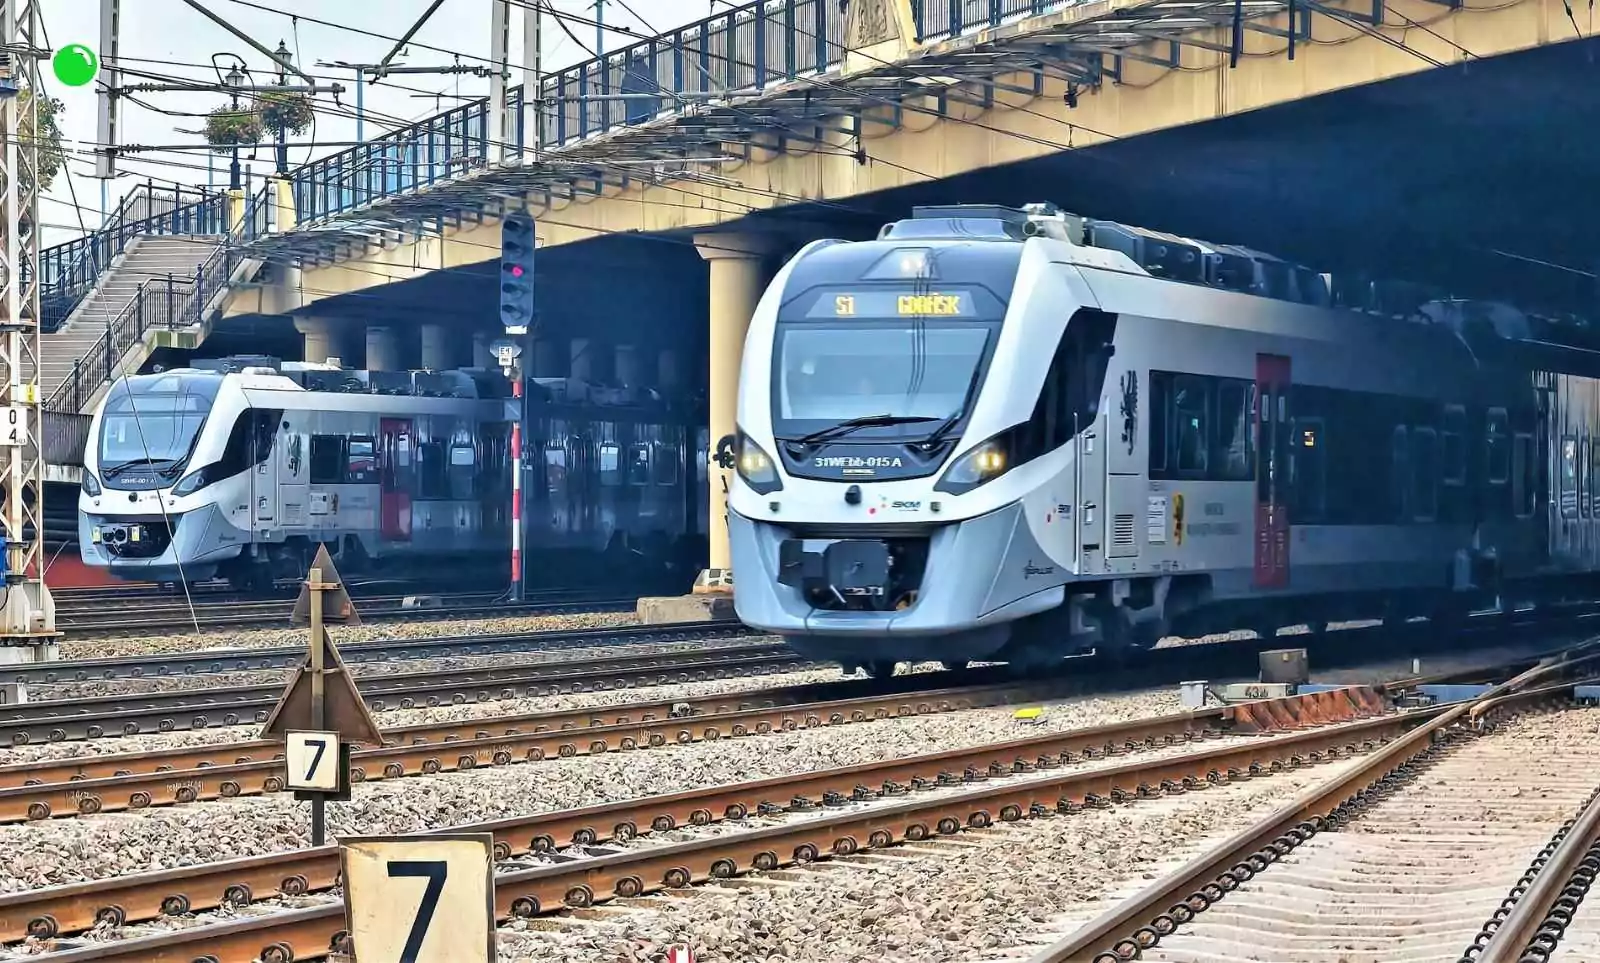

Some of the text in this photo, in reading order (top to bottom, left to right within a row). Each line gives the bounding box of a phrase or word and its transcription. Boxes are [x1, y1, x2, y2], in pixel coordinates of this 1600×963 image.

[836, 296, 854, 314] S1
[9, 409, 17, 425] 0
[9, 428, 17, 444] 4
[891, 457, 902, 467] A
[304, 739, 326, 781] 7
[387, 861, 447, 963] 7
